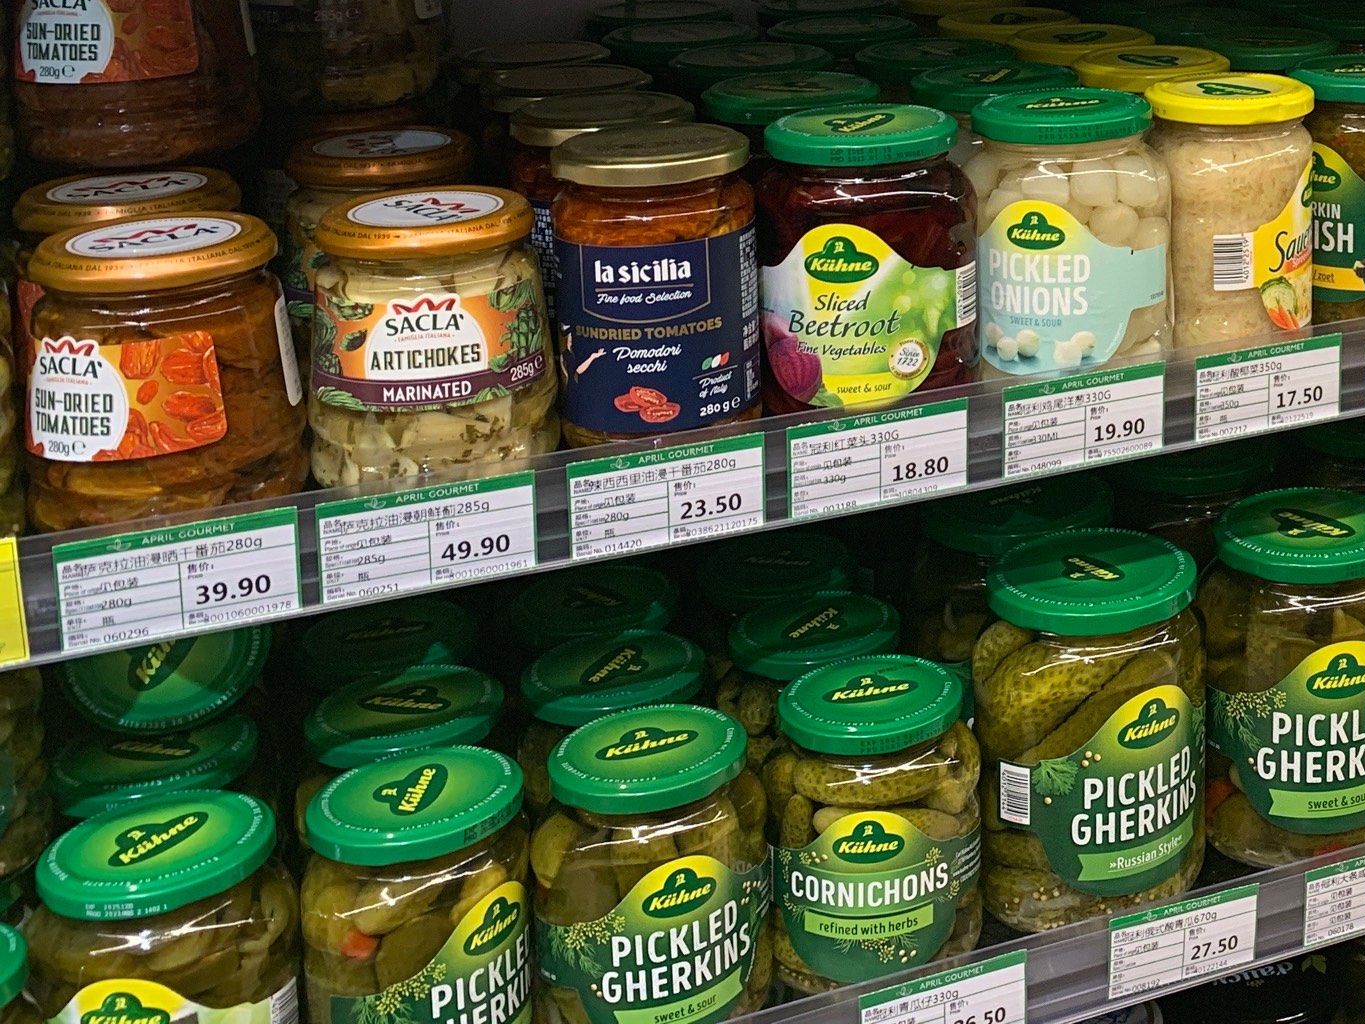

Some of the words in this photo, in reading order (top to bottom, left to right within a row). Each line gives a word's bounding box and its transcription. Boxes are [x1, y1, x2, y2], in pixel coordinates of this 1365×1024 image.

[26, 23, 100, 43] SUN-DRIED
[26, 42, 98, 62] TOMATOES
[1012, 228, 1060, 243] Kühne
[594, 259, 618, 284] la
[619, 258, 692, 285] sicilia
[808, 257, 873, 275] Kühne
[989, 247, 1091, 284] PICKLED
[814, 289, 871, 313] Sliced
[991, 281, 1089, 317] ONIONS
[576, 324, 643, 343] SUNDRIED
[644, 317, 724, 339] TOMATOES
[789, 309, 902, 339] Beetroot
[370, 342, 482, 372] ARTICHOKES
[821, 340, 888, 357] Vegetables
[35, 393, 113, 416] SUN-DRIED
[382, 380, 472, 403] MARINATED
[1276, 386, 1323, 410] 17.50
[35, 415, 112, 437] TOMATOES
[1093, 417, 1145, 443] 19.90
[892, 455, 949, 483] 18.80
[680, 492, 742, 521] 23.50
[441, 532, 511, 562] 49.90
[195, 573, 271, 606] 39.90
[1082, 745, 1192, 812] PICKLED
[1070, 768, 1197, 848] GHERKINS
[118, 814, 199, 866] Kühne
[791, 861, 949, 909] CORNICHONS
[611, 900, 738, 968] PICKLED
[819, 918, 858, 936] refined
[859, 919, 885, 935] with
[885, 914, 919, 933] herbs
[1191, 934, 1238, 961] 27.50
[602, 921, 751, 1004] GHERKINS
